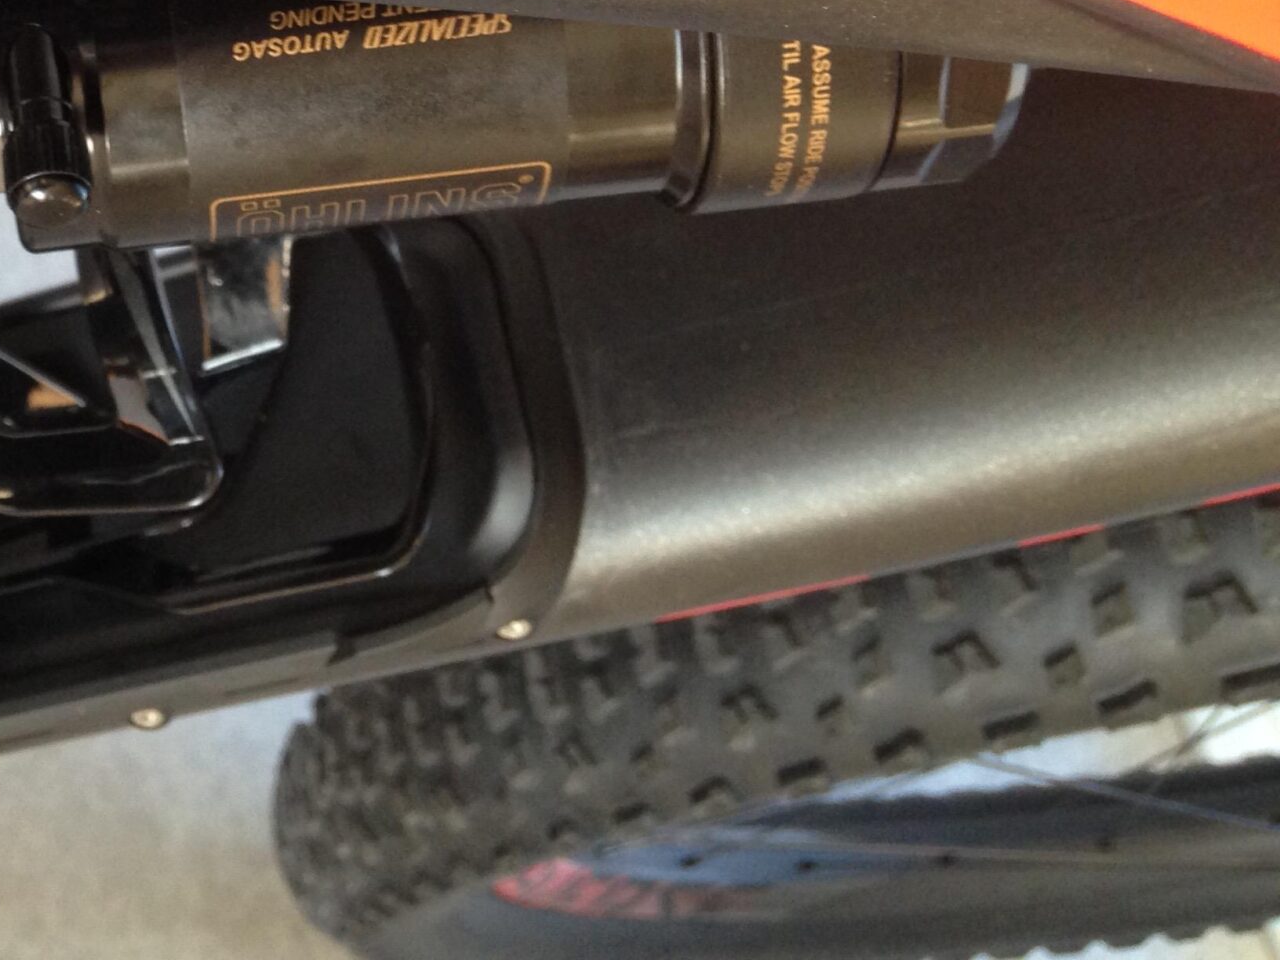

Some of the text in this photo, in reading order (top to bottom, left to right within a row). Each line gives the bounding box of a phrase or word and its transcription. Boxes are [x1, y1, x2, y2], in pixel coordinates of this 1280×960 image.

[269, 0, 376, 30] PENDING
[231, 13, 513, 61] SPECIALIZED AUTOSAG
[782, 74, 802, 108] AIR
[810, 43, 832, 125] ASSUME
[778, 112, 801, 159] FLOW
[804, 128, 828, 165] RIDE
